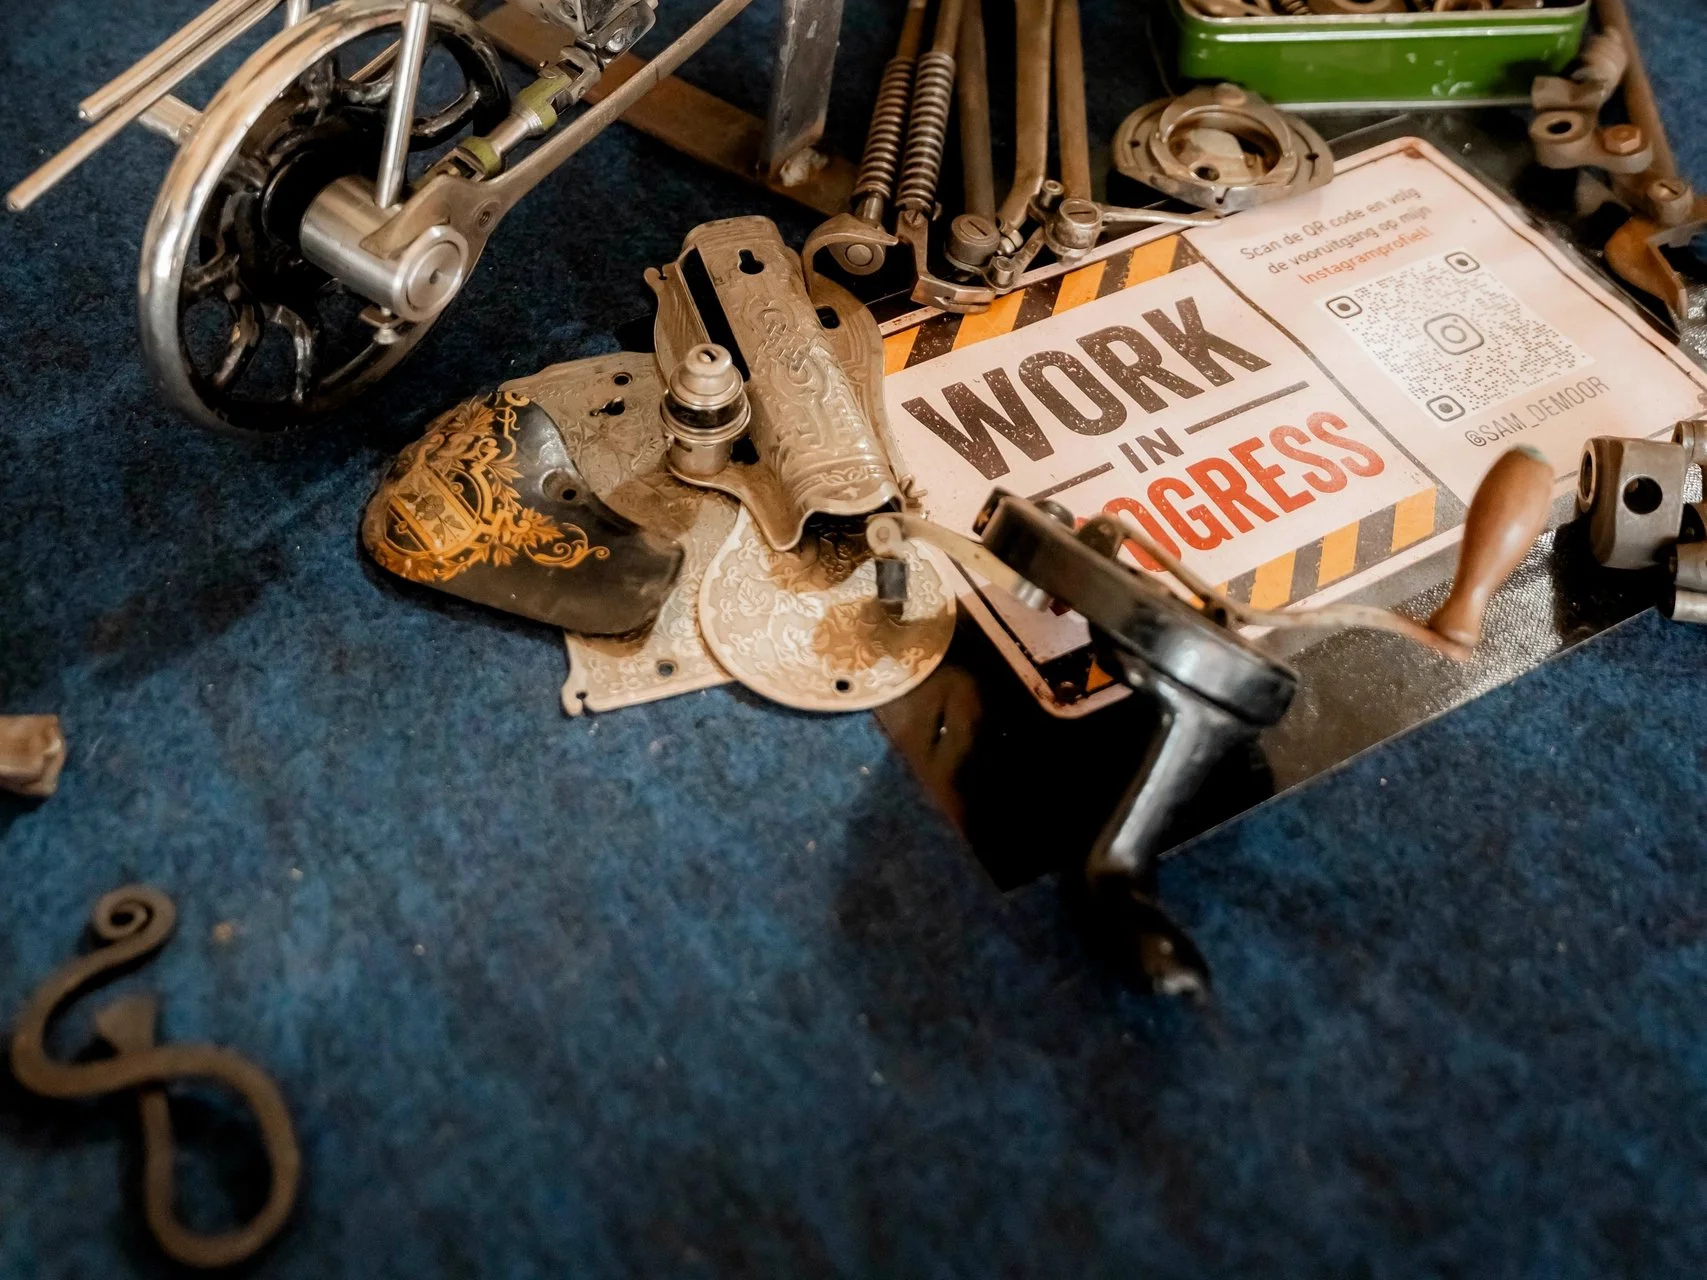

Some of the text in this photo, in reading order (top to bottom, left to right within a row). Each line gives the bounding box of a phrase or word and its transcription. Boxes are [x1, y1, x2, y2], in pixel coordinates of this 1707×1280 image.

[1240, 187, 1421, 260] Scan de QR code en volg
[1267, 206, 1432, 275] de vooruitgang op mijn
[1298, 226, 1433, 284] Instagramprofiel!
[900, 296, 1273, 481] WORK
[1463, 375, 1611, 448] @SAM_DEMOOR
[1117, 426, 1185, 474] IN
[1076, 411, 1386, 573] OGRESS
